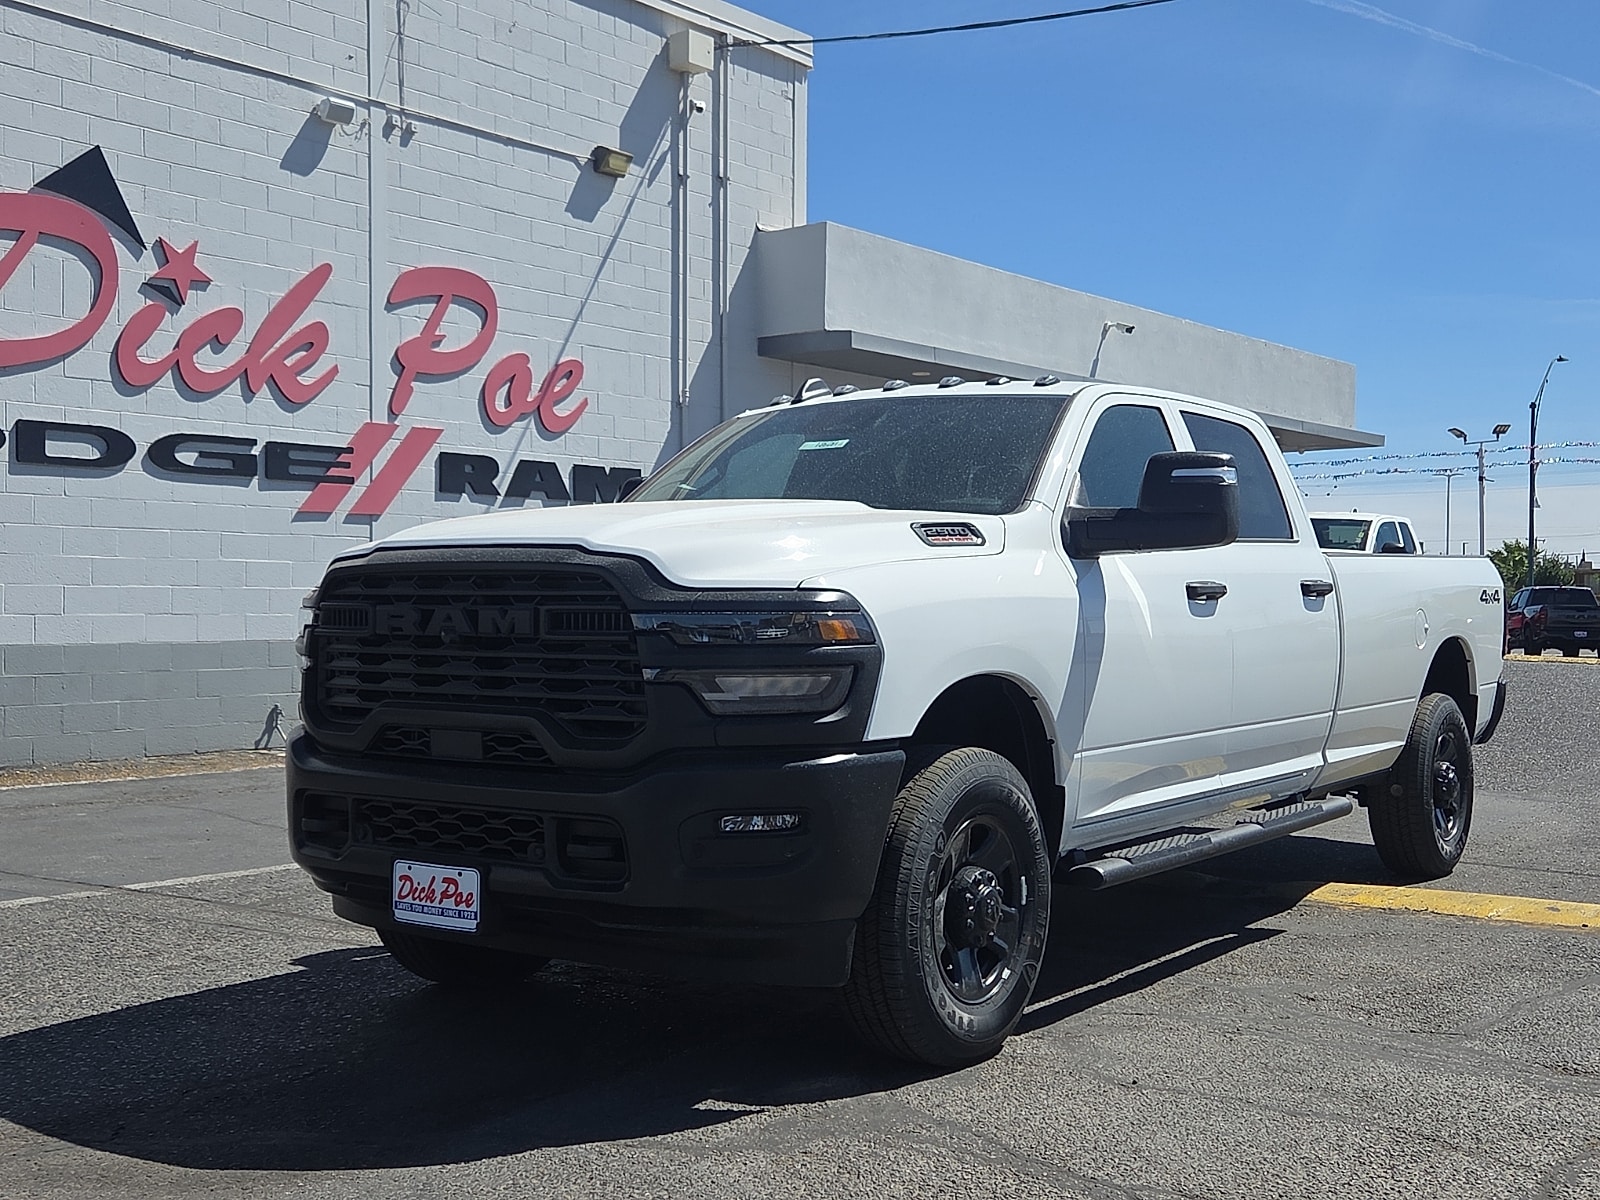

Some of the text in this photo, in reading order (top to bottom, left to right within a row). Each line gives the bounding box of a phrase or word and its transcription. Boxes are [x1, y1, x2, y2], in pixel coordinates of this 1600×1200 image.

[0, 192, 589, 434] Dick Poe
[0, 418, 642, 504] DGE RAM
[923, 527, 969, 537] 2500
[375, 604, 534, 637] RAM
[398, 874, 475, 909] Dick Poe
[396, 902, 476, 920] SAVES YOU MONEY SINCE 1928
